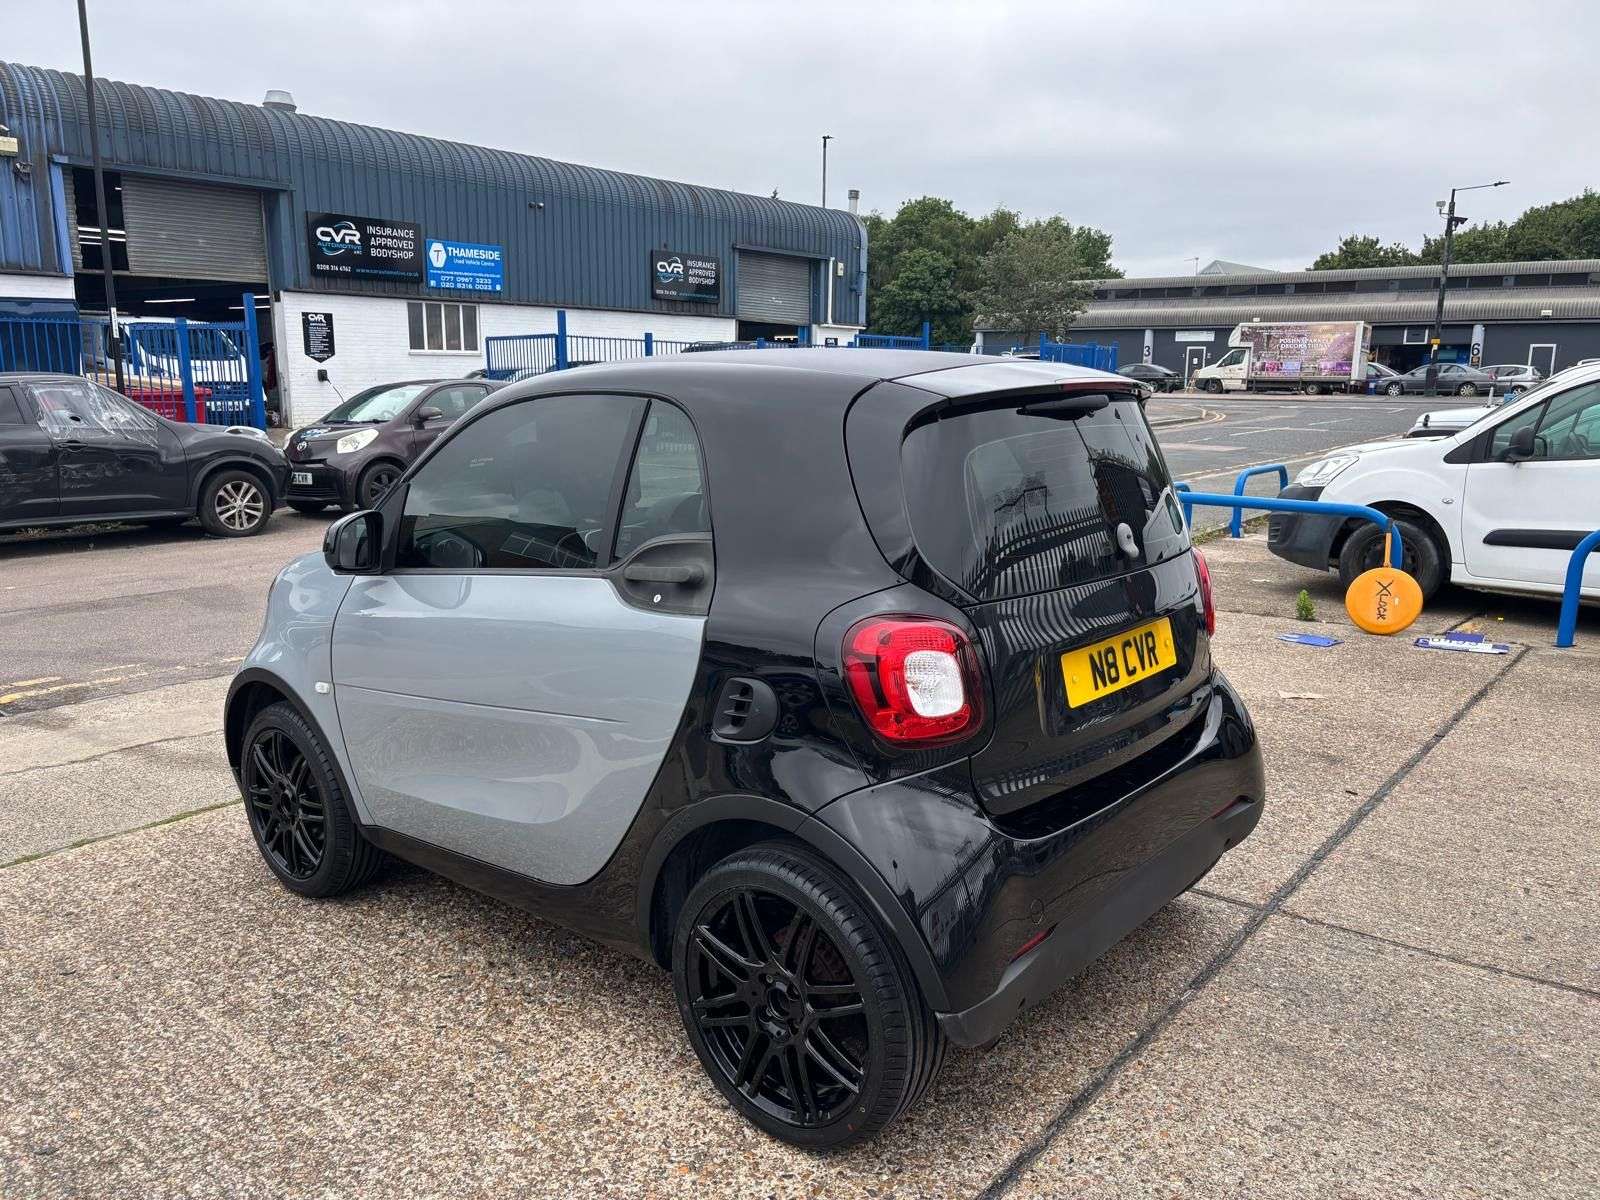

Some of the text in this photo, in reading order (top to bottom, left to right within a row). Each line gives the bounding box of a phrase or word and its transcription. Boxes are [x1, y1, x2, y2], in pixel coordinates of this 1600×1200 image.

[316, 226, 361, 245] CVR
[366, 225, 415, 239] INSURANCE
[317, 241, 362, 251] AUTOMOTIVE
[370, 237, 414, 250] APPROVED
[370, 248, 414, 260] BODYSHOP
[447, 246, 501, 261] THAMESIDE
[657, 261, 684, 275] CVR
[686, 260, 717, 270] INSURANCE
[688, 268, 716, 278] APPROVED
[688, 276, 716, 285] BODYSHOP
[308, 313, 327, 323] CVR
[1143, 345, 1151, 357] 3
[1471, 343, 1481, 356] 6
[1088, 630, 1160, 691] N8 CVR
